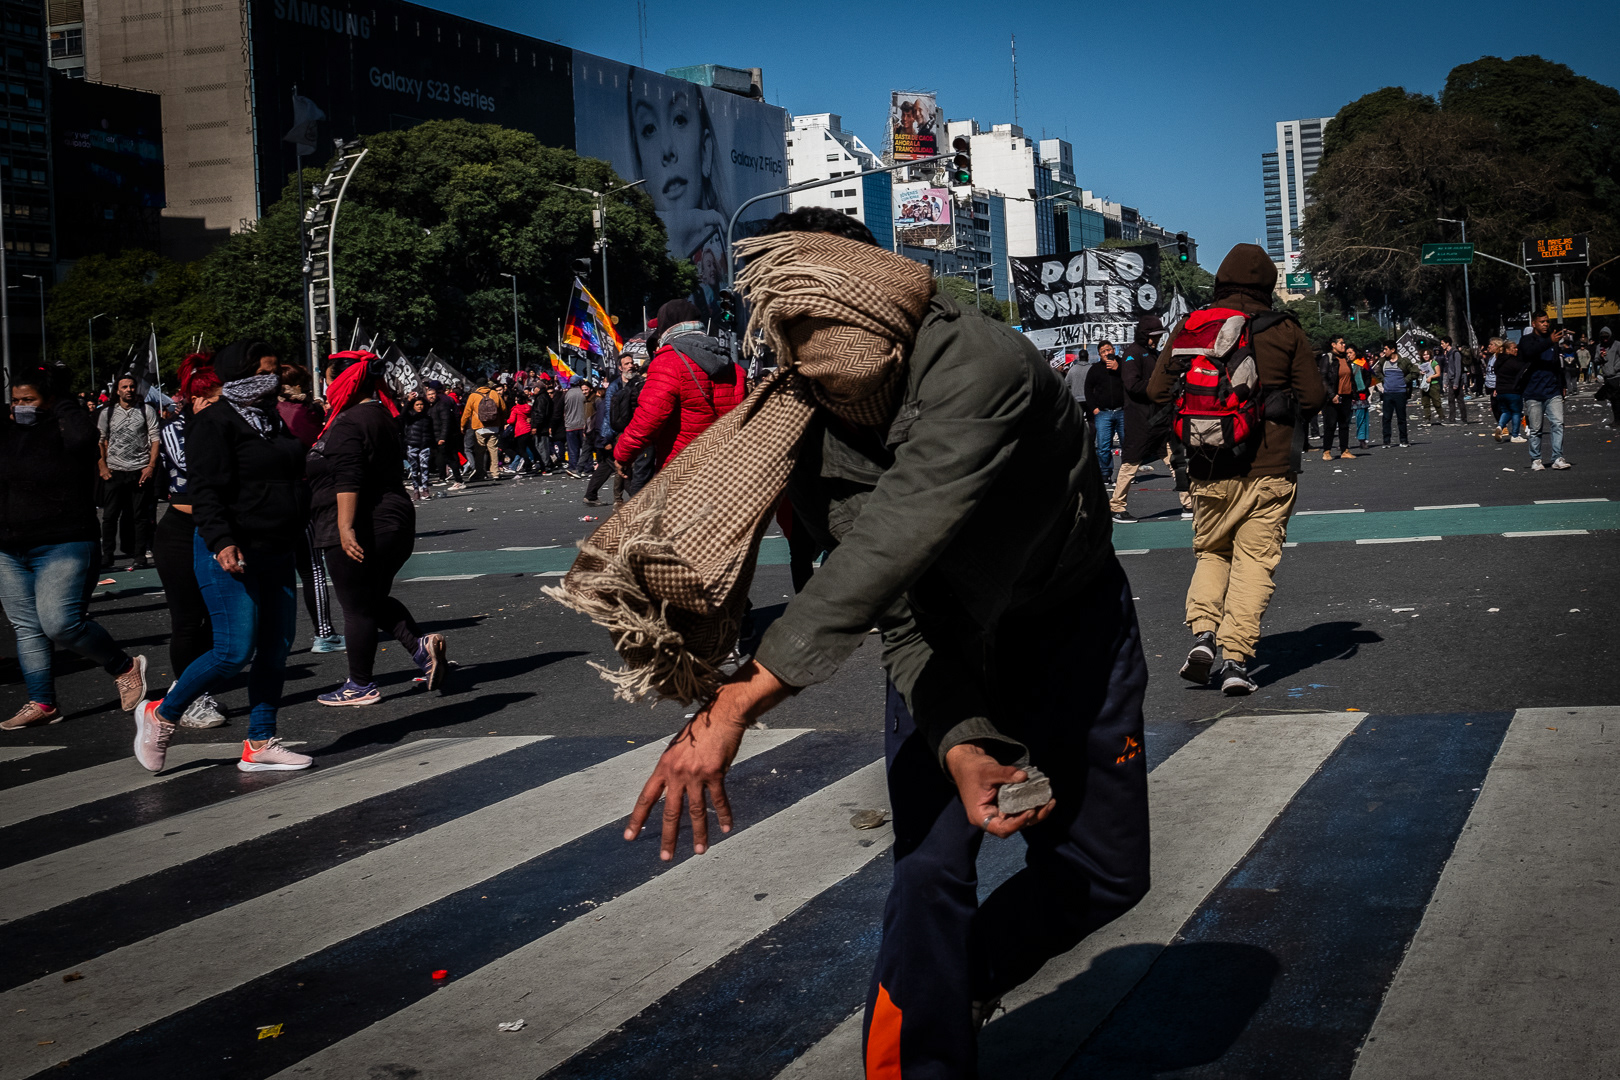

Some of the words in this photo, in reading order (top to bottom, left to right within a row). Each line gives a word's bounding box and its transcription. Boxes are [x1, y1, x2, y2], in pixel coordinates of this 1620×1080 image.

[274, 0, 371, 39] SAMSUNG
[369, 66, 423, 103] Galaxy
[426, 78, 450, 102] S23
[453, 84, 496, 113] Series
[894, 133, 912, 141] BASTA
[731, 149, 758, 173] Galaxy
[759, 156, 764, 171] Z
[765, 156, 782, 177] Flip5
[1537, 239, 1545, 247] SI
[1547, 238, 1573, 246] MANEJAS
[1542, 250, 1567, 258] CELULAR
[1548, 244, 1563, 252] USES
[1041, 252, 1144, 291] POLO
[1034, 284, 1158, 321] OBRERO
[1082, 323, 1134, 343] NORT
